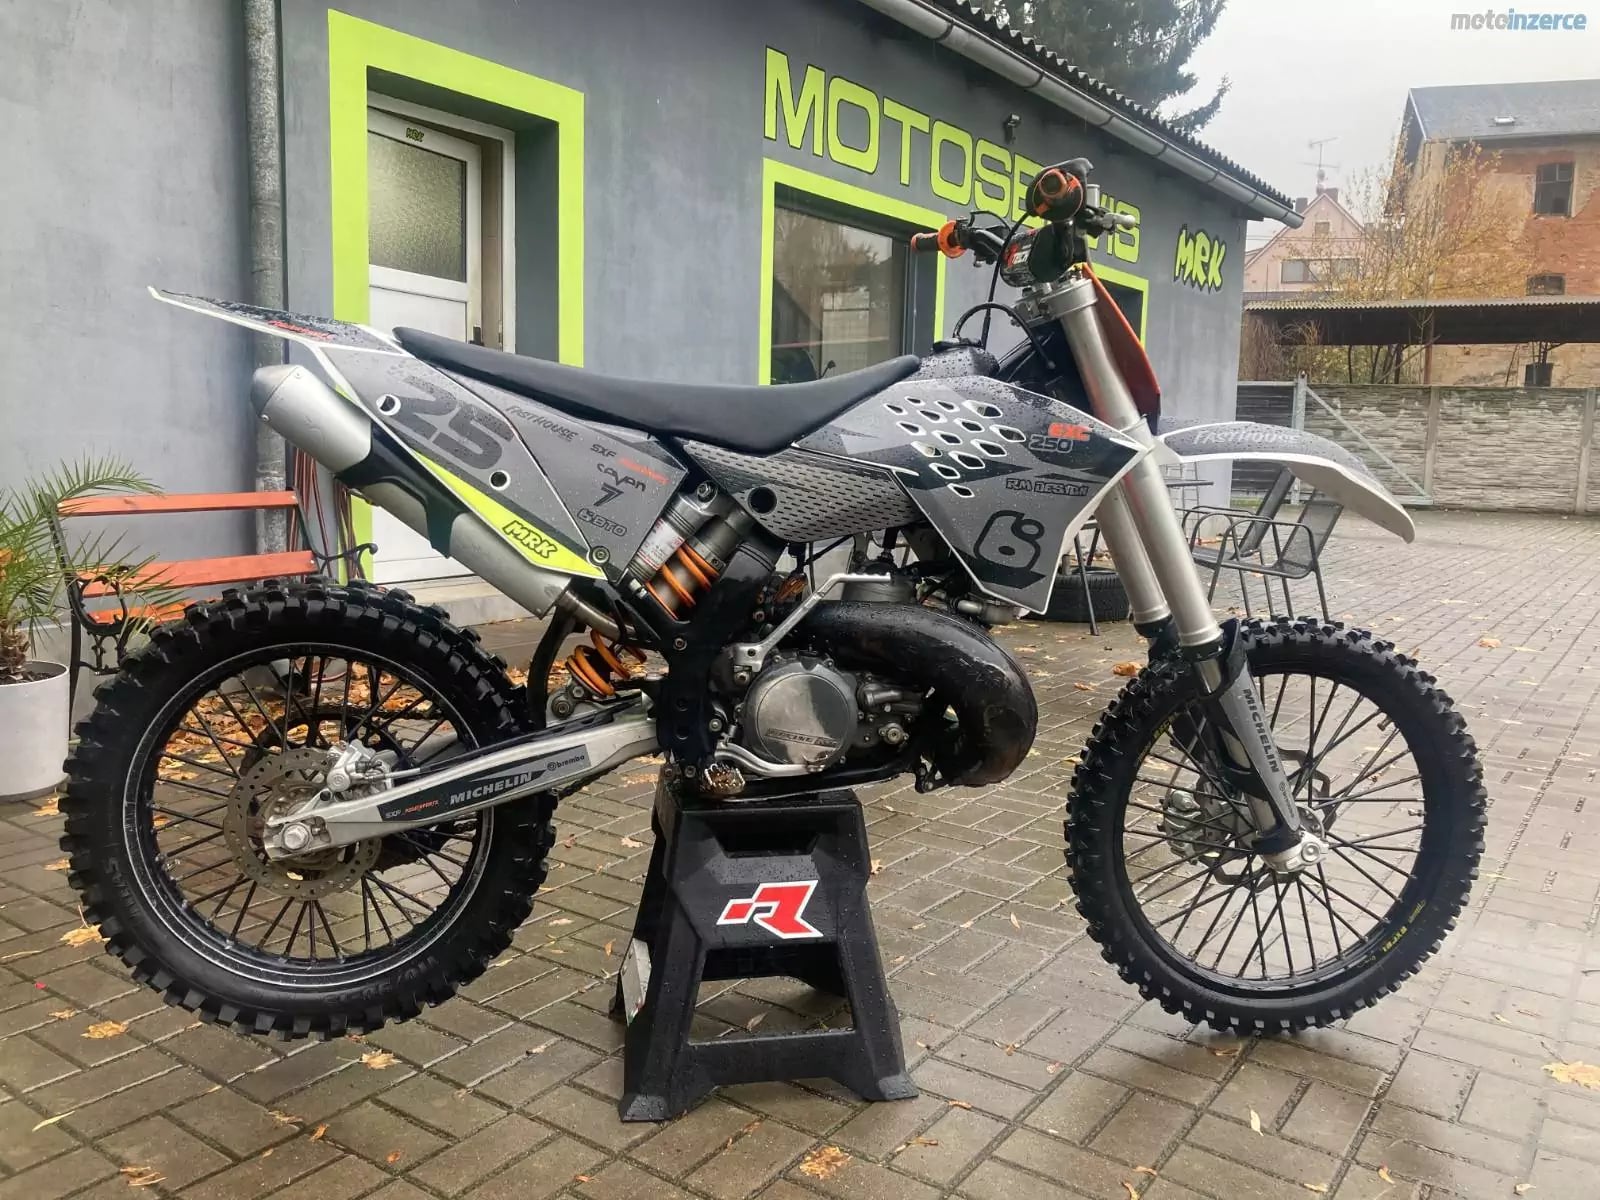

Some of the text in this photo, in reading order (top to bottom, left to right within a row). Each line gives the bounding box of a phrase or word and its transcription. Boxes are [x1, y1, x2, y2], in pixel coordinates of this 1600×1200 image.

[1174, 223, 1227, 294] MRK
[396, 374, 516, 470] 25
[590, 443, 617, 458] SXF
[1028, 434, 1074, 454] 250
[592, 482, 625, 507] 7
[1005, 477, 1032, 492] RM
[502, 519, 559, 559] MRK
[1242, 688, 1280, 774] MICHELIN
[556, 753, 586, 769] brembo
[449, 772, 533, 806] MICHELIN
